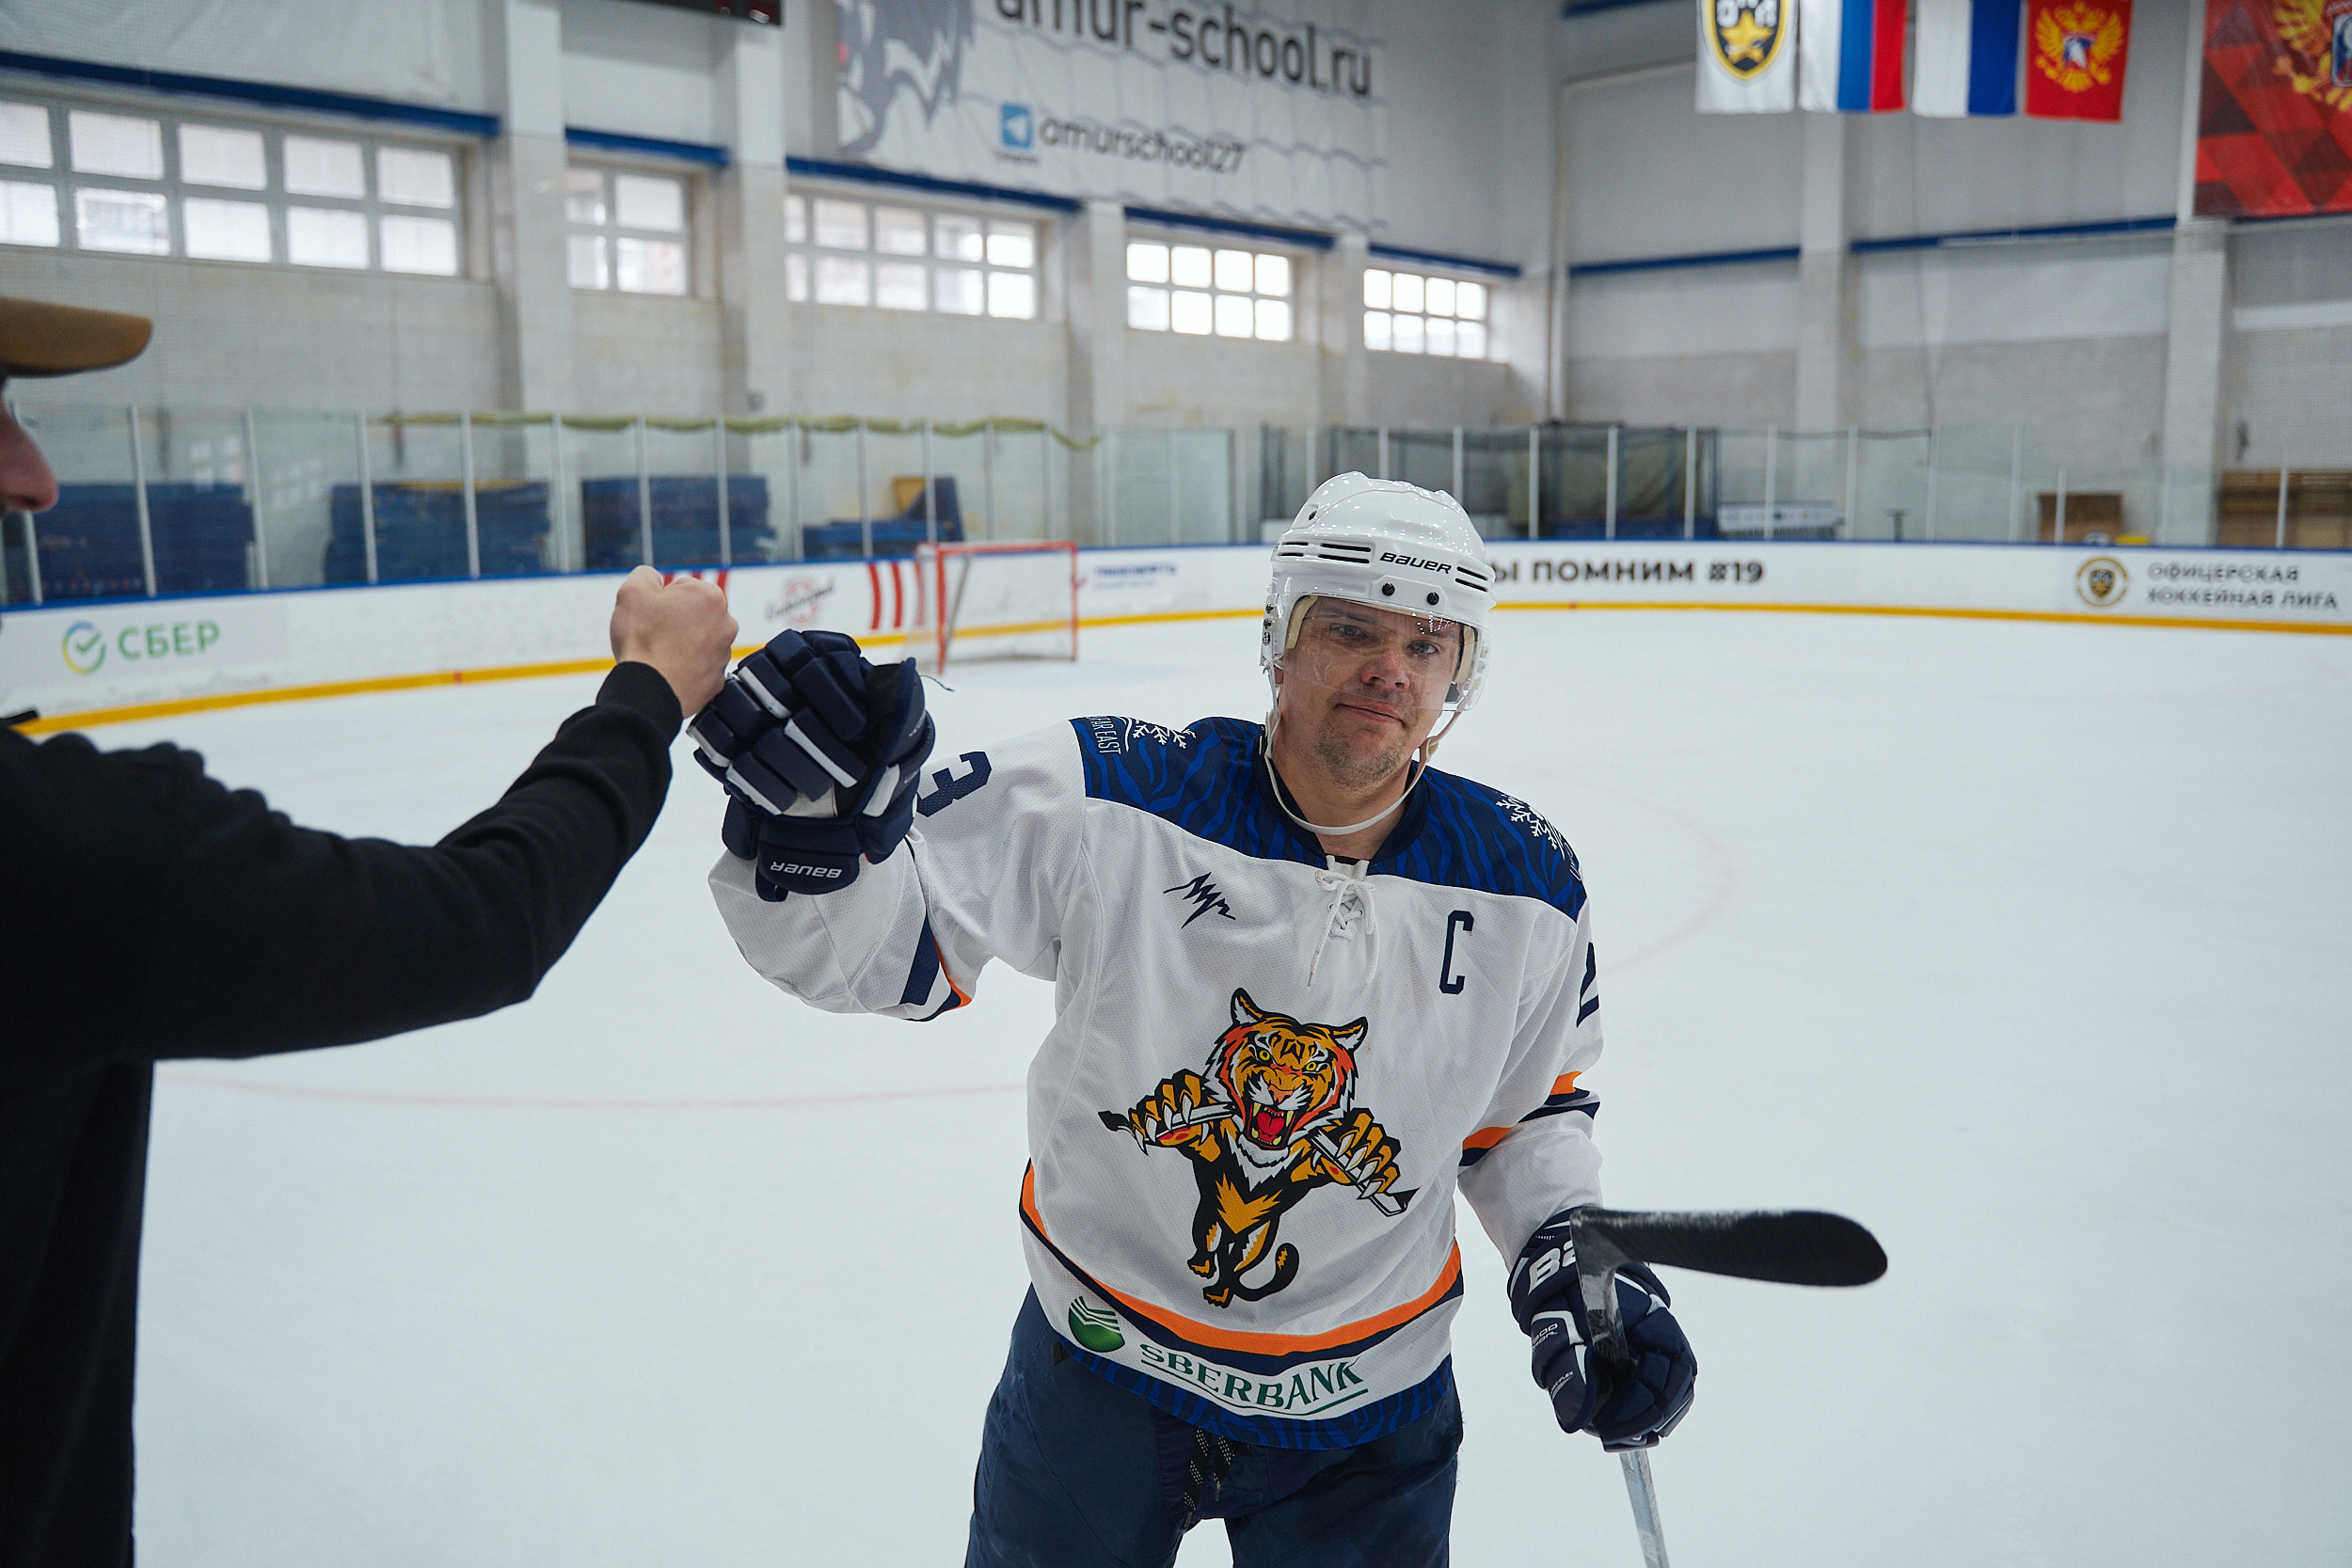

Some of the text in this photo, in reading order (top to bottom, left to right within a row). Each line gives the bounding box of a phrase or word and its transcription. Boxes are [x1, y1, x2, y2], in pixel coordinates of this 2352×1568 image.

[1379, 551, 1453, 575] BAUER
[1490, 562, 1765, 584] Ы ПОМНИМ #19
[2148, 562, 2300, 583] ОФИЦЕРСКАЯ
[2147, 585, 2339, 610] ХОККЕЙНАЯ ЛИГА
[118, 621, 220, 659] СБЕР
[1094, 730, 1121, 754] EAST
[770, 861, 843, 879] BAUER
[1439, 910, 1474, 995] C
[1139, 1342, 1364, 1410] SBERBANK
